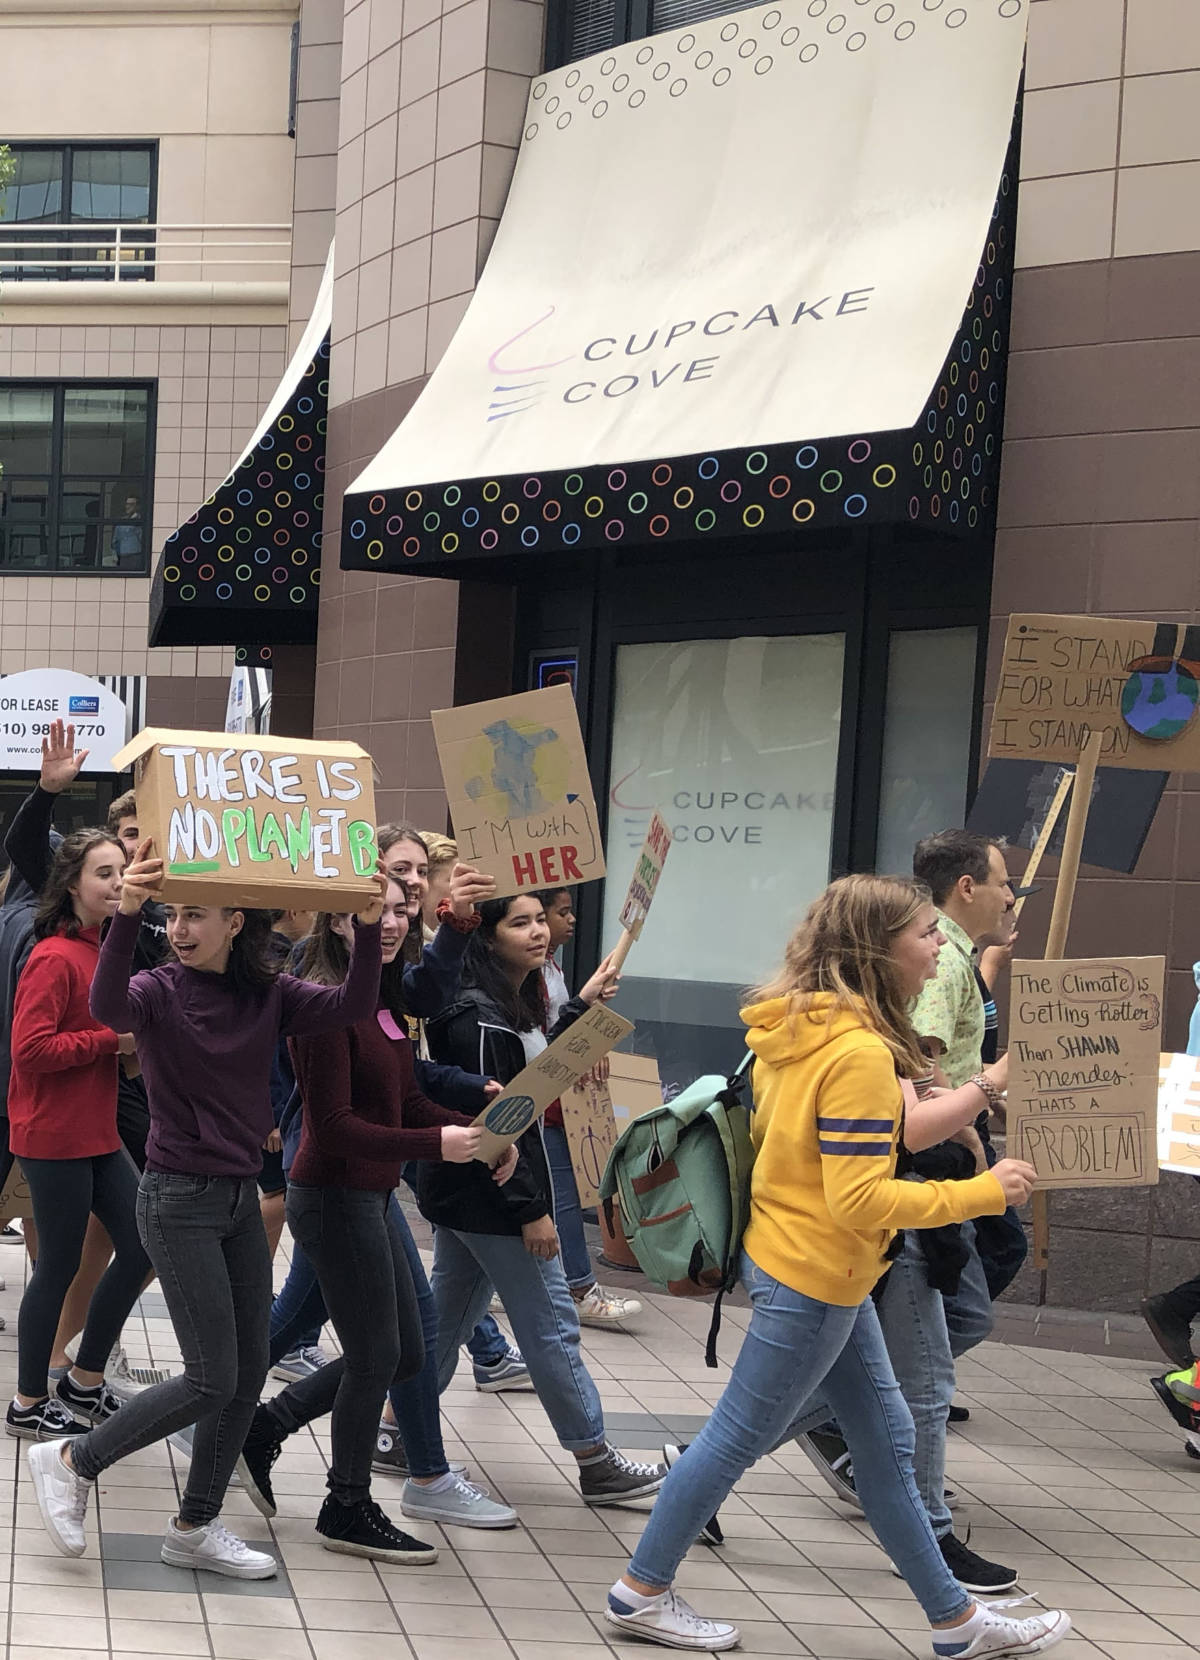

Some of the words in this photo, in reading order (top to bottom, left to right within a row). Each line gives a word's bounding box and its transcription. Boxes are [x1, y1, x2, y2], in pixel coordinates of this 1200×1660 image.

[583, 287, 875, 361] CUPCAKE
[563, 356, 720, 404] COVE
[1008, 637, 1038, 663] I
[1051, 636, 1147, 671] STAND
[21, 699, 59, 712] LEASE
[1000, 673, 1052, 706] FOR
[1063, 677, 1128, 707] WHAT
[996, 718, 1018, 746] I
[1029, 720, 1091, 752] STAND
[1100, 726, 1132, 753] ON
[160, 747, 307, 803] THERE
[315, 759, 362, 800] IS
[673, 791, 835, 810] CUPCAKE
[169, 801, 221, 862] NO
[221, 805, 347, 878] PLANET
[348, 820, 380, 878] B
[460, 820, 515, 860] I'M
[672, 825, 763, 844] COVE
[512, 845, 584, 886] HER
[1011, 974, 1052, 994] The
[1062, 971, 1130, 994] Climate
[1019, 1000, 1089, 1027] Getting
[1095, 1000, 1148, 1022] hotter
[1013, 1040, 1053, 1062] Than
[1057, 1035, 1120, 1060] SHAWN
[1022, 1097, 1076, 1112] THATS
[1090, 1097, 1099, 1110] A
[1024, 1123, 1138, 1175] PROBLEM
